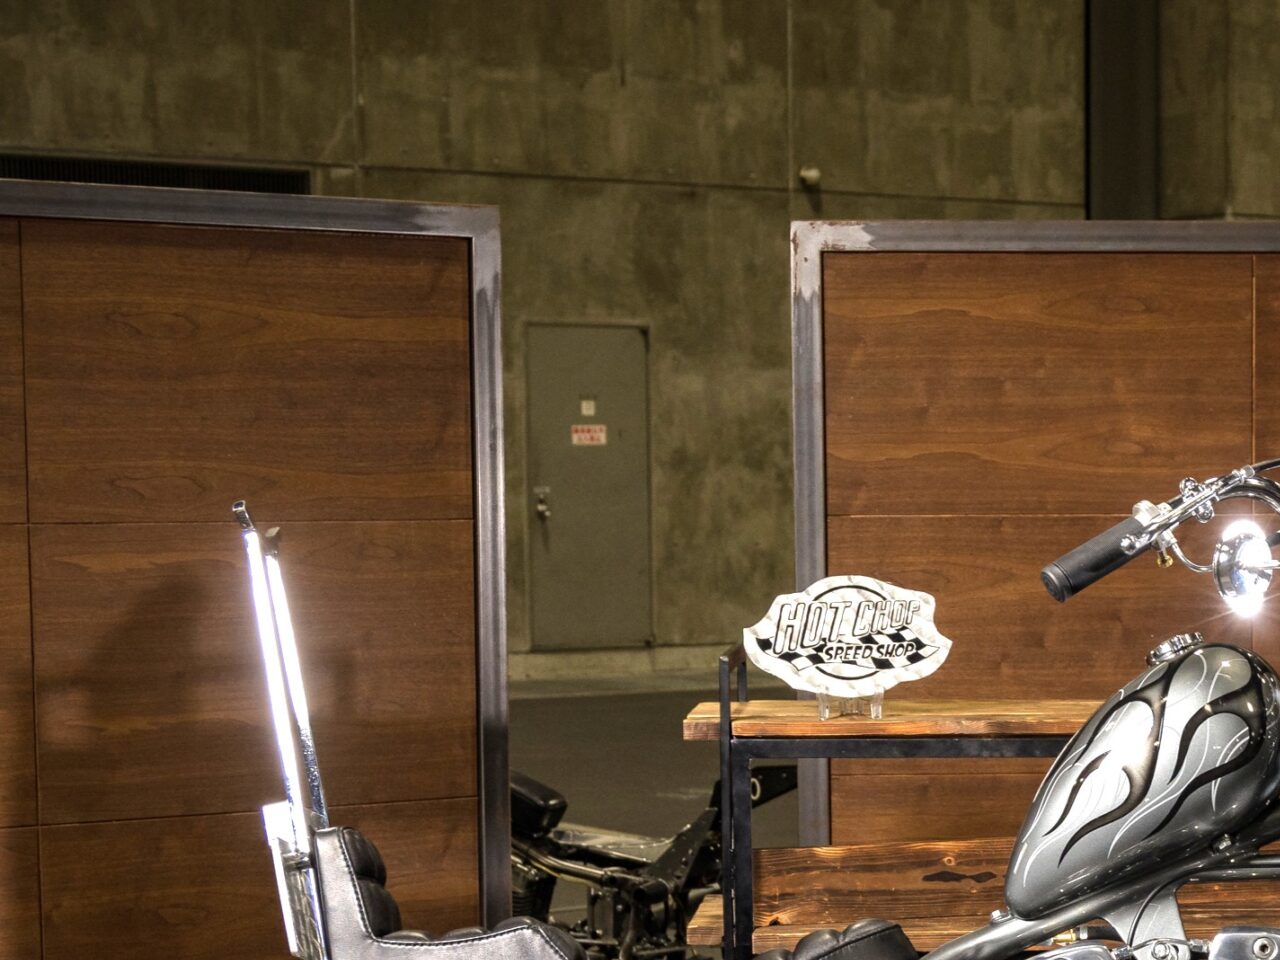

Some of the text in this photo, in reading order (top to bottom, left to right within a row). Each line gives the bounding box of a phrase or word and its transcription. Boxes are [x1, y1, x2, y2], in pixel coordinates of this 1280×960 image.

[773, 600, 920, 654] HOT CHOP
[823, 642, 917, 661] SPEED SHOP
